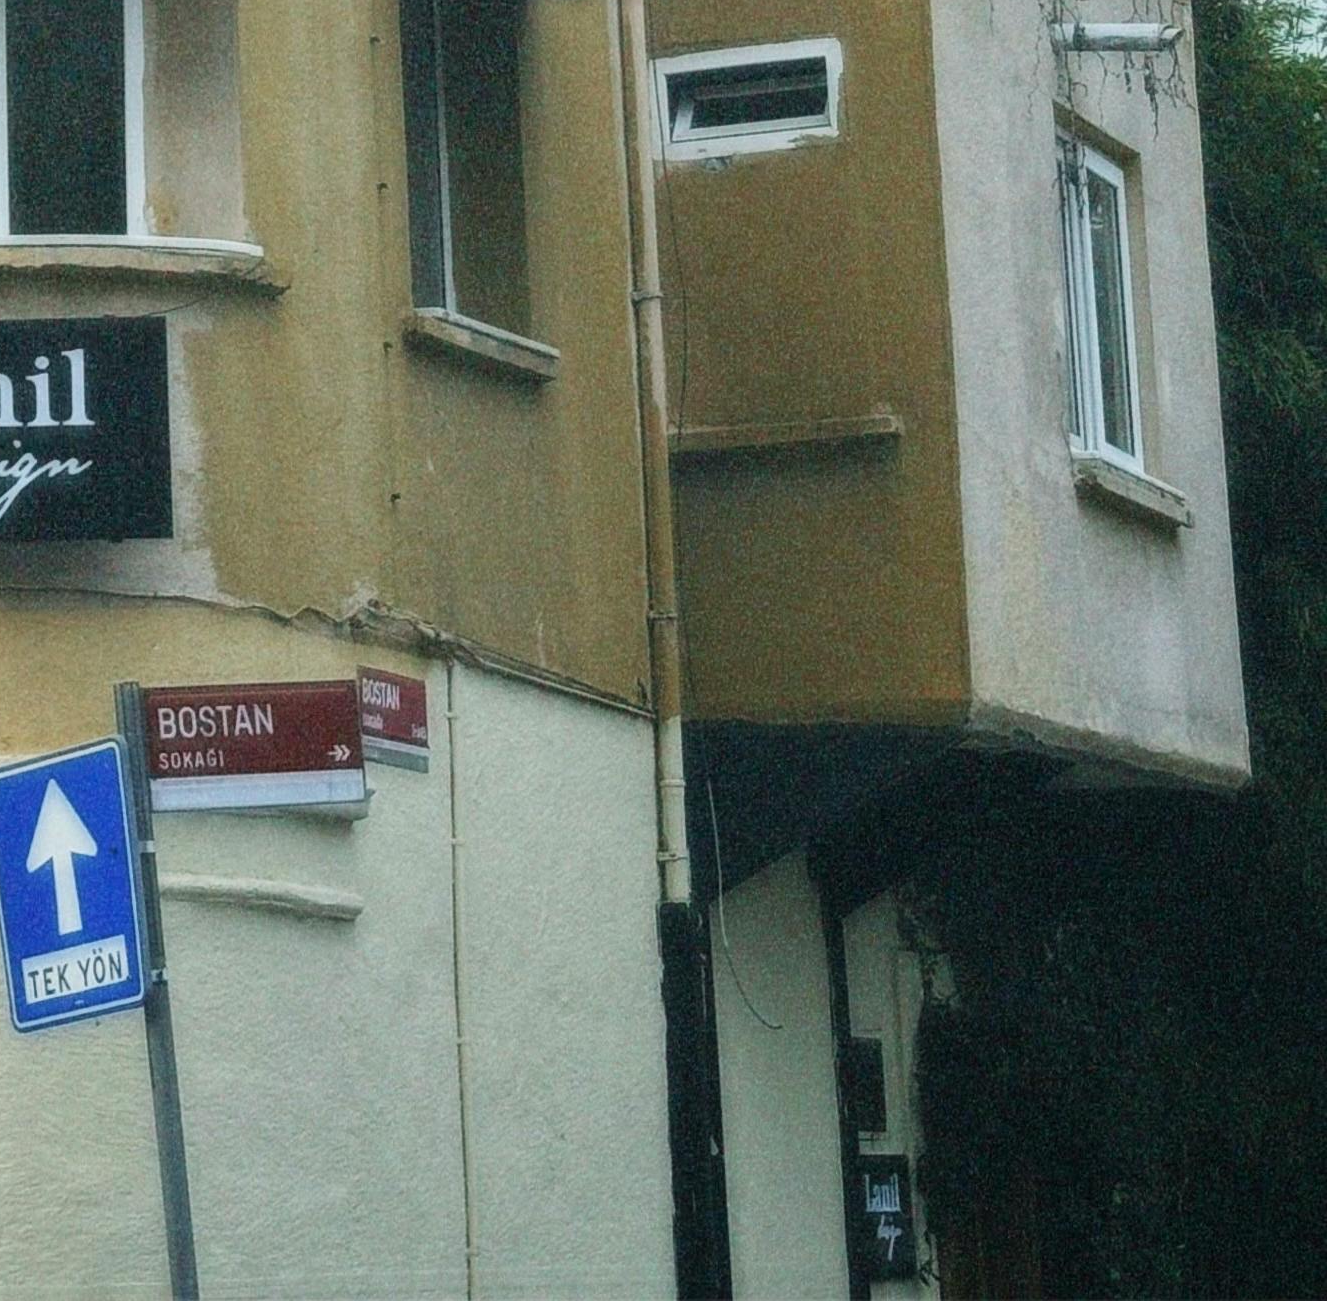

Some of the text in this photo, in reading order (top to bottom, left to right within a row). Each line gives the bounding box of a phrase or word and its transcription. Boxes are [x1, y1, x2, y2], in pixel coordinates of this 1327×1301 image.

[158, 704, 274, 739] BOSTAN
[159, 745, 224, 770] SOKAĞI
[28, 947, 122, 999] TEK YÖN
